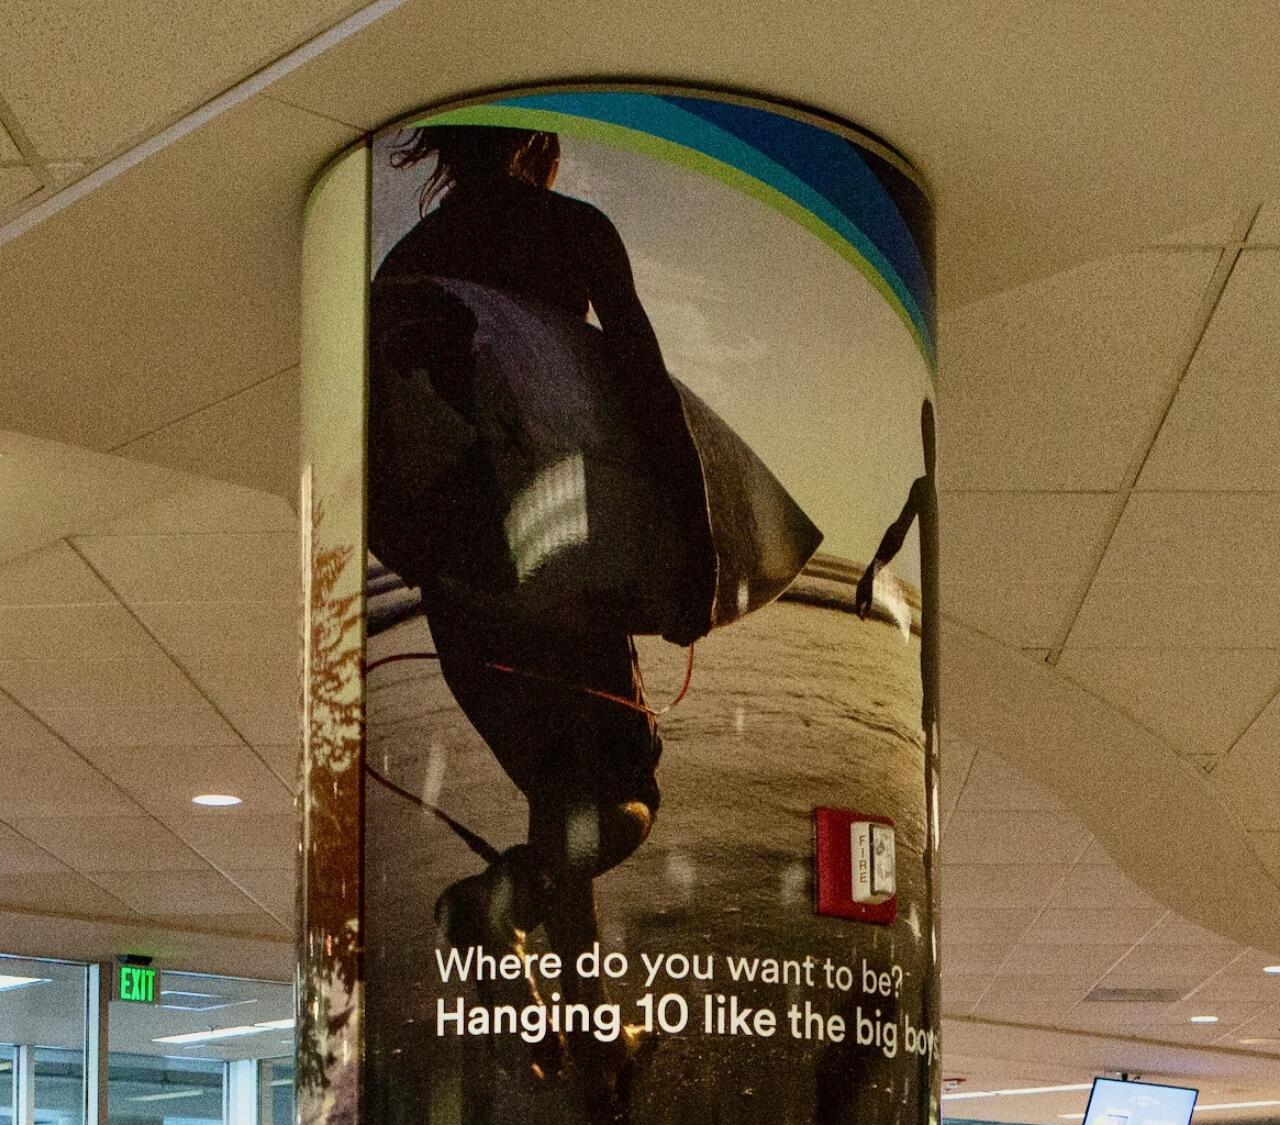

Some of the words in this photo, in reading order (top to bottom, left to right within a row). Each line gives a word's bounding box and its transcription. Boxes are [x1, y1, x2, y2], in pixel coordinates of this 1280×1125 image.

[858, 835, 868, 883] FIRE
[120, 967, 156, 1002] EXIT
[435, 945, 563, 982] Where
[576, 941, 629, 980] do
[641, 953, 715, 987] you
[726, 955, 816, 988] want
[823, 957, 854, 992] to
[862, 959, 904, 999] be?
[436, 992, 622, 1044] Hanging
[635, 994, 689, 1035] 10
[704, 995, 777, 1038] like
[787, 1001, 847, 1043] the
[856, 1006, 898, 1059] big
